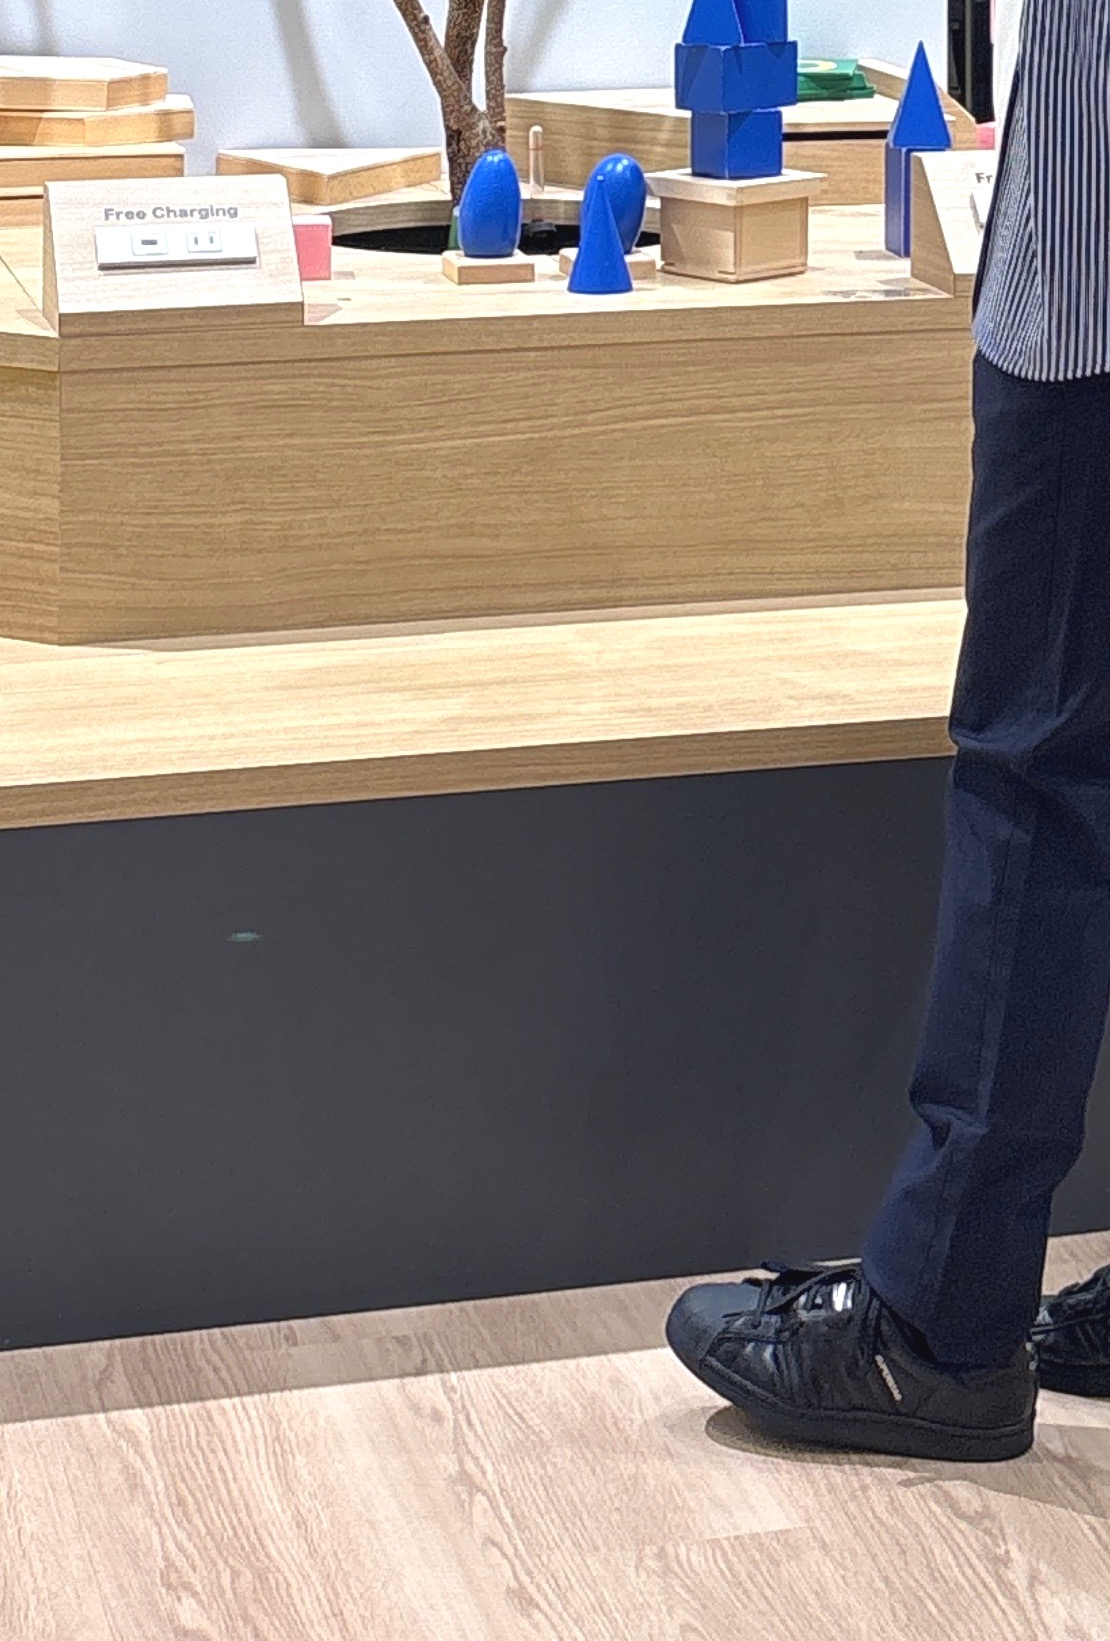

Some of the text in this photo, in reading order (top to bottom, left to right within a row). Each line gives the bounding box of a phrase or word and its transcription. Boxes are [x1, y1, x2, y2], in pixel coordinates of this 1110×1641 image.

[975, 172, 994, 184] Fr
[103, 204, 239, 221] Free Charging
